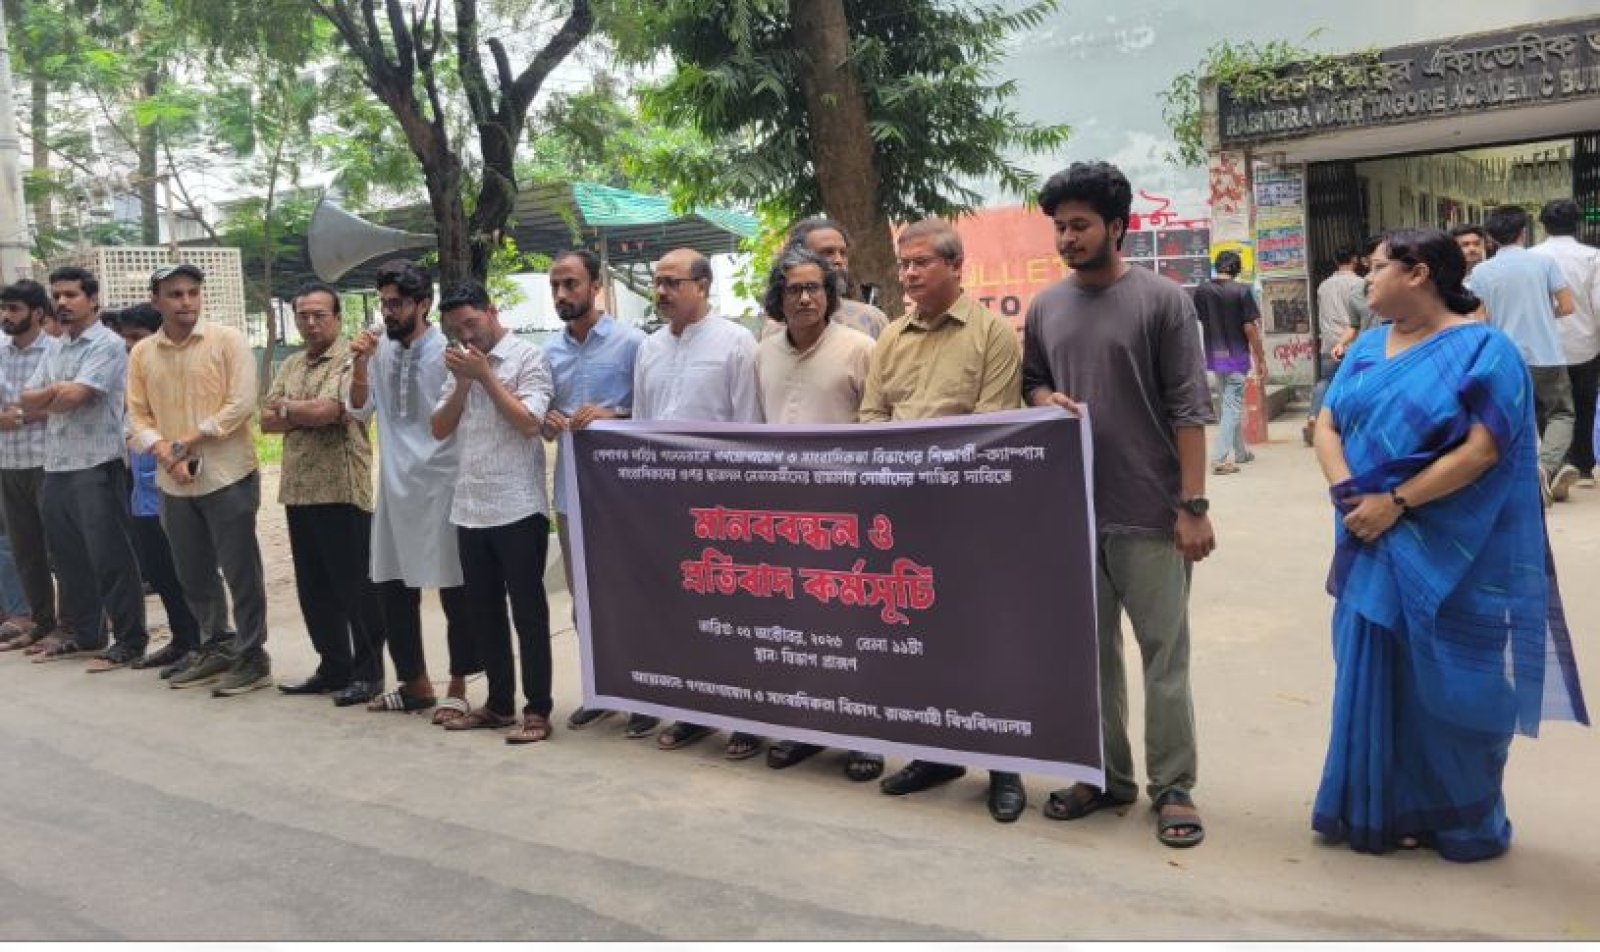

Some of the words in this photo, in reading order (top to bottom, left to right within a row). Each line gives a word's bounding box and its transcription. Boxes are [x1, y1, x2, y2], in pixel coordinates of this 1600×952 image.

[1366, 87, 1446, 119] TAGORE
[690, 505, 860, 549] মানববন্ধন
[867, 513, 894, 550] ও
[680, 547, 795, 599] প্রতিবাদ
[798, 558, 936, 626] কর্মসূচি
